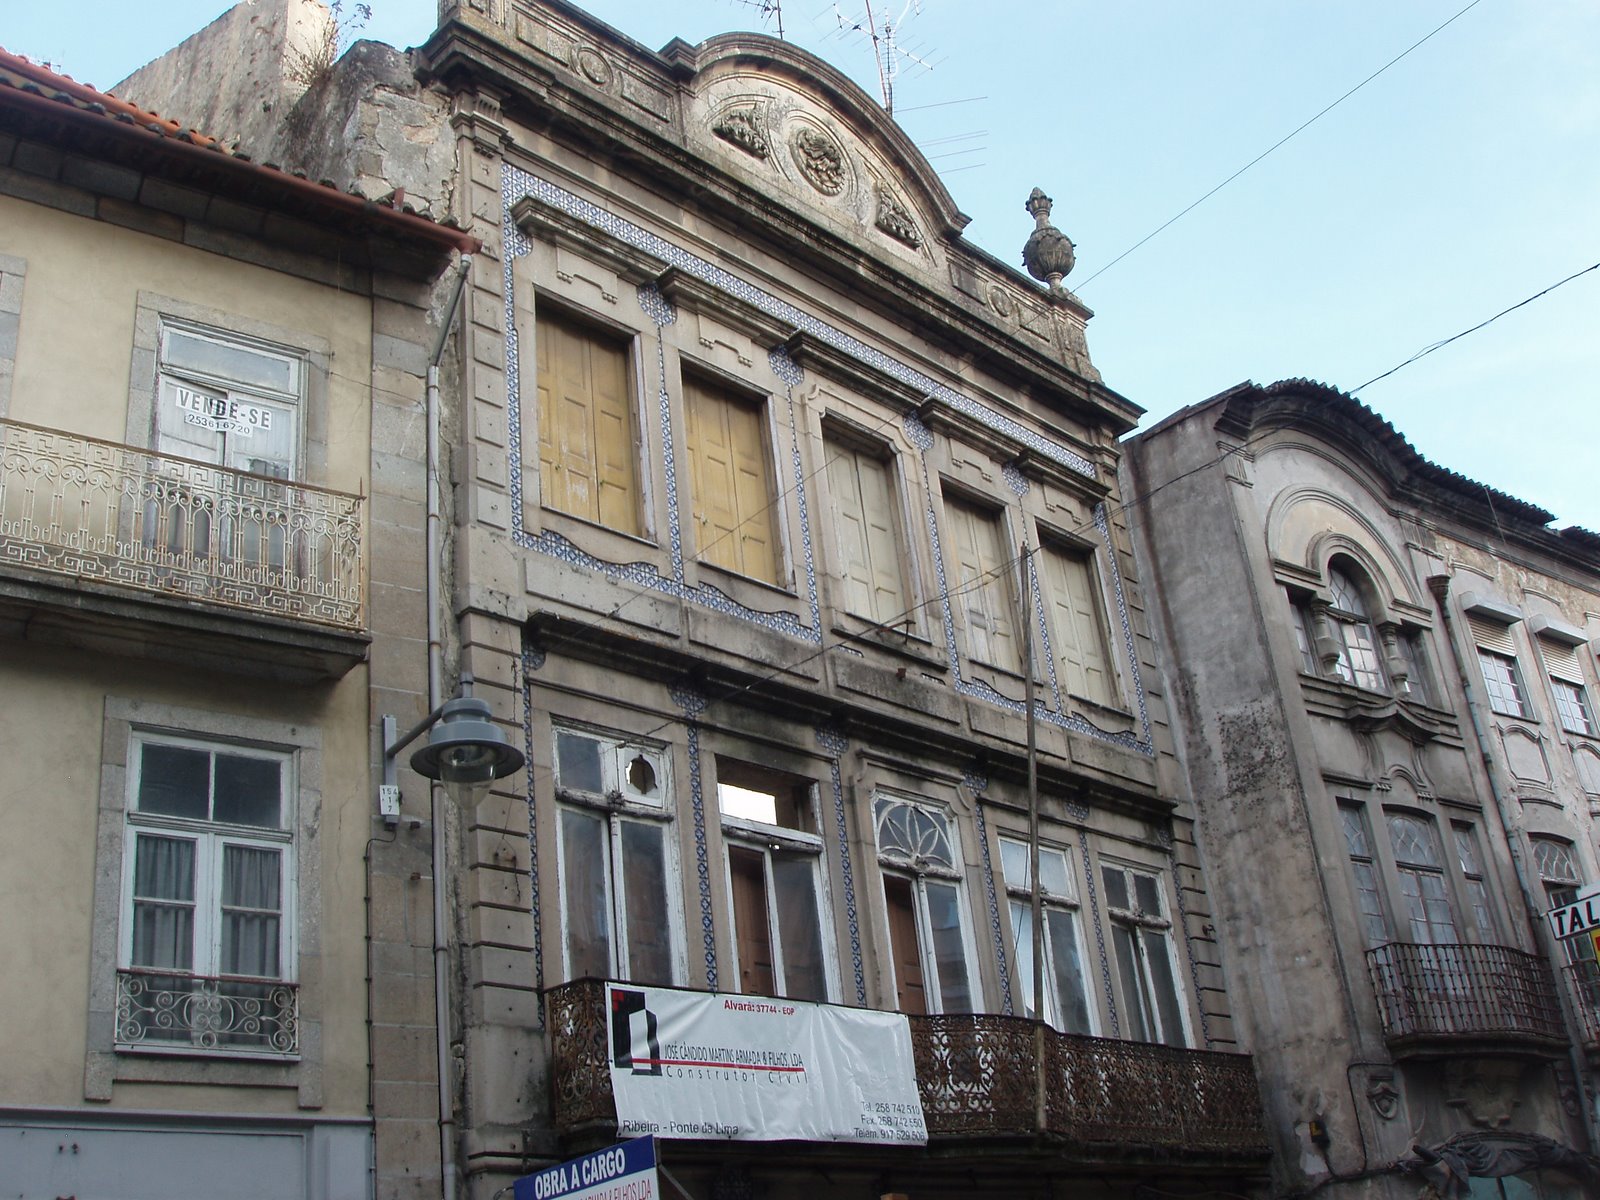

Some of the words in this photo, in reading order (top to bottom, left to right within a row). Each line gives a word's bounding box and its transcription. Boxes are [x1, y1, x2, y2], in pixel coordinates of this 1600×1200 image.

[179, 389, 270, 428] VENDE-SE
[756, 1004, 777, 1014] 37744
[665, 1041, 678, 1060] JOSÉ
[708, 1047, 734, 1063] MARTINS
[735, 1049, 761, 1065] ARMADA
[666, 1065, 756, 1082] Construtor
[622, 1119, 659, 1133] Ribeira
[670, 1121, 699, 1134] Ponte
[716, 1122, 739, 1136] Lima
[880, 1129, 894, 1140] 917
[535, 1167, 569, 1200] OBRA
[571, 1163, 580, 1190] A
[582, 1147, 626, 1186] CARGO
